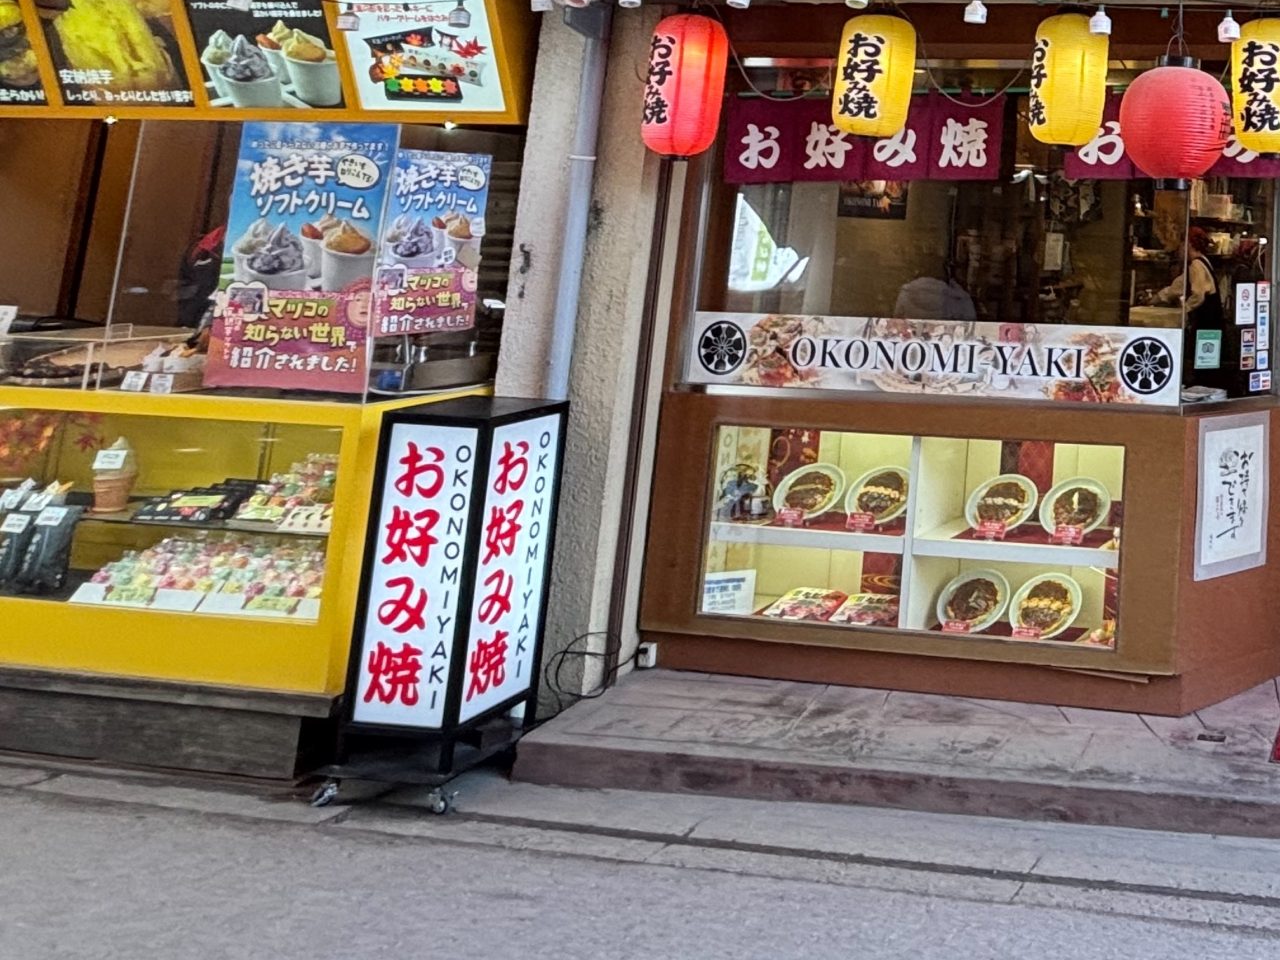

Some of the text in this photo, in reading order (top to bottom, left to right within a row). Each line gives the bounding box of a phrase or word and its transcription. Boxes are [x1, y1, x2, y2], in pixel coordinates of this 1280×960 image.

[838, 32, 885, 120] お好み焼
[1239, 40, 1280, 133] お好み焼
[739, 118, 988, 169] お好み焼
[250, 153, 336, 197] 焼き芋
[396, 163, 457, 197] 焼き芋
[256, 189, 371, 220] ソフトクリーム
[400, 191, 478, 214] ソフトクリーム
[407, 275, 450, 290] マツコの
[269, 298, 329, 320] マツコの
[381, 314, 470, 334] 紹介されました!
[242, 321, 358, 353] 知らない世界で
[791, 337, 1085, 379] OKONOMI-YAKI
[230, 346, 357, 373] 紹介されました!
[363, 440, 446, 707] お好み焼
[465, 440, 530, 703] お好み焼
[516, 431, 551, 680] OKONOMIYAKI
[429, 445, 473, 711] OKONOMIYAKI
